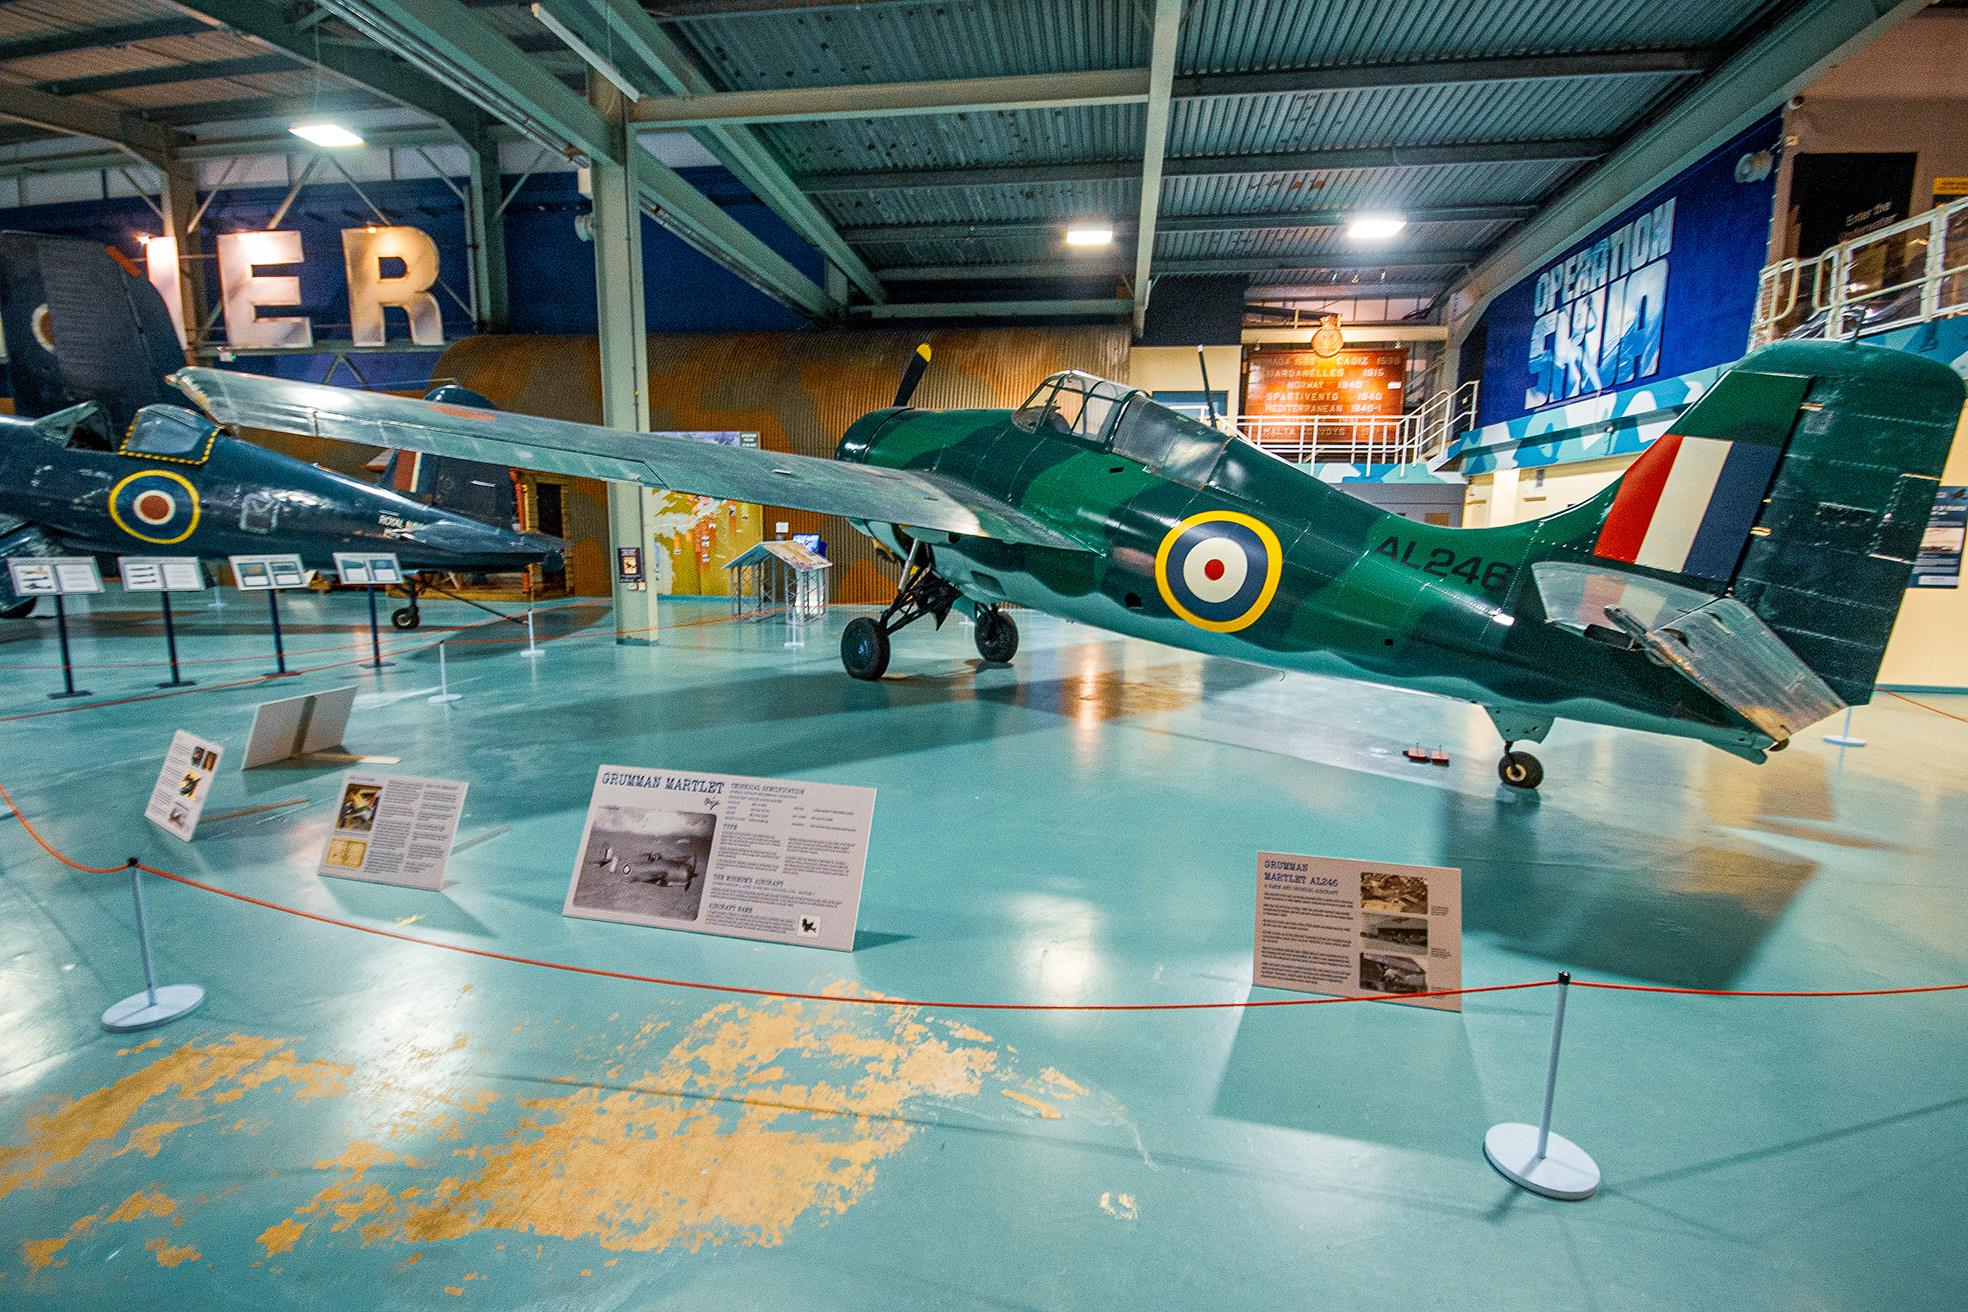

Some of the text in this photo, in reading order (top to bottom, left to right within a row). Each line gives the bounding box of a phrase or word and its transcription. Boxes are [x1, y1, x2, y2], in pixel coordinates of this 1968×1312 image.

[1534, 197, 1677, 317] OPERATION
[1524, 258, 1670, 410] SKUA
[1336, 356, 1369, 366] CADIZ
[1267, 368, 1385, 378] DARDANELLES 1915
[1286, 380, 1363, 389] NORWAY 1940
[1265, 391, 1383, 401] SPARTIVENTO 1940
[1264, 403, 1344, 413] MEDITERRANEAN
[1263, 427, 1296, 436] MALTA
[1372, 535, 1513, 592] AL246
[602, 771, 725, 794] GRUMMAN MARTLET
[1264, 860, 1309, 872] GRUMMAN
[1264, 872, 1307, 884] MARTLET
